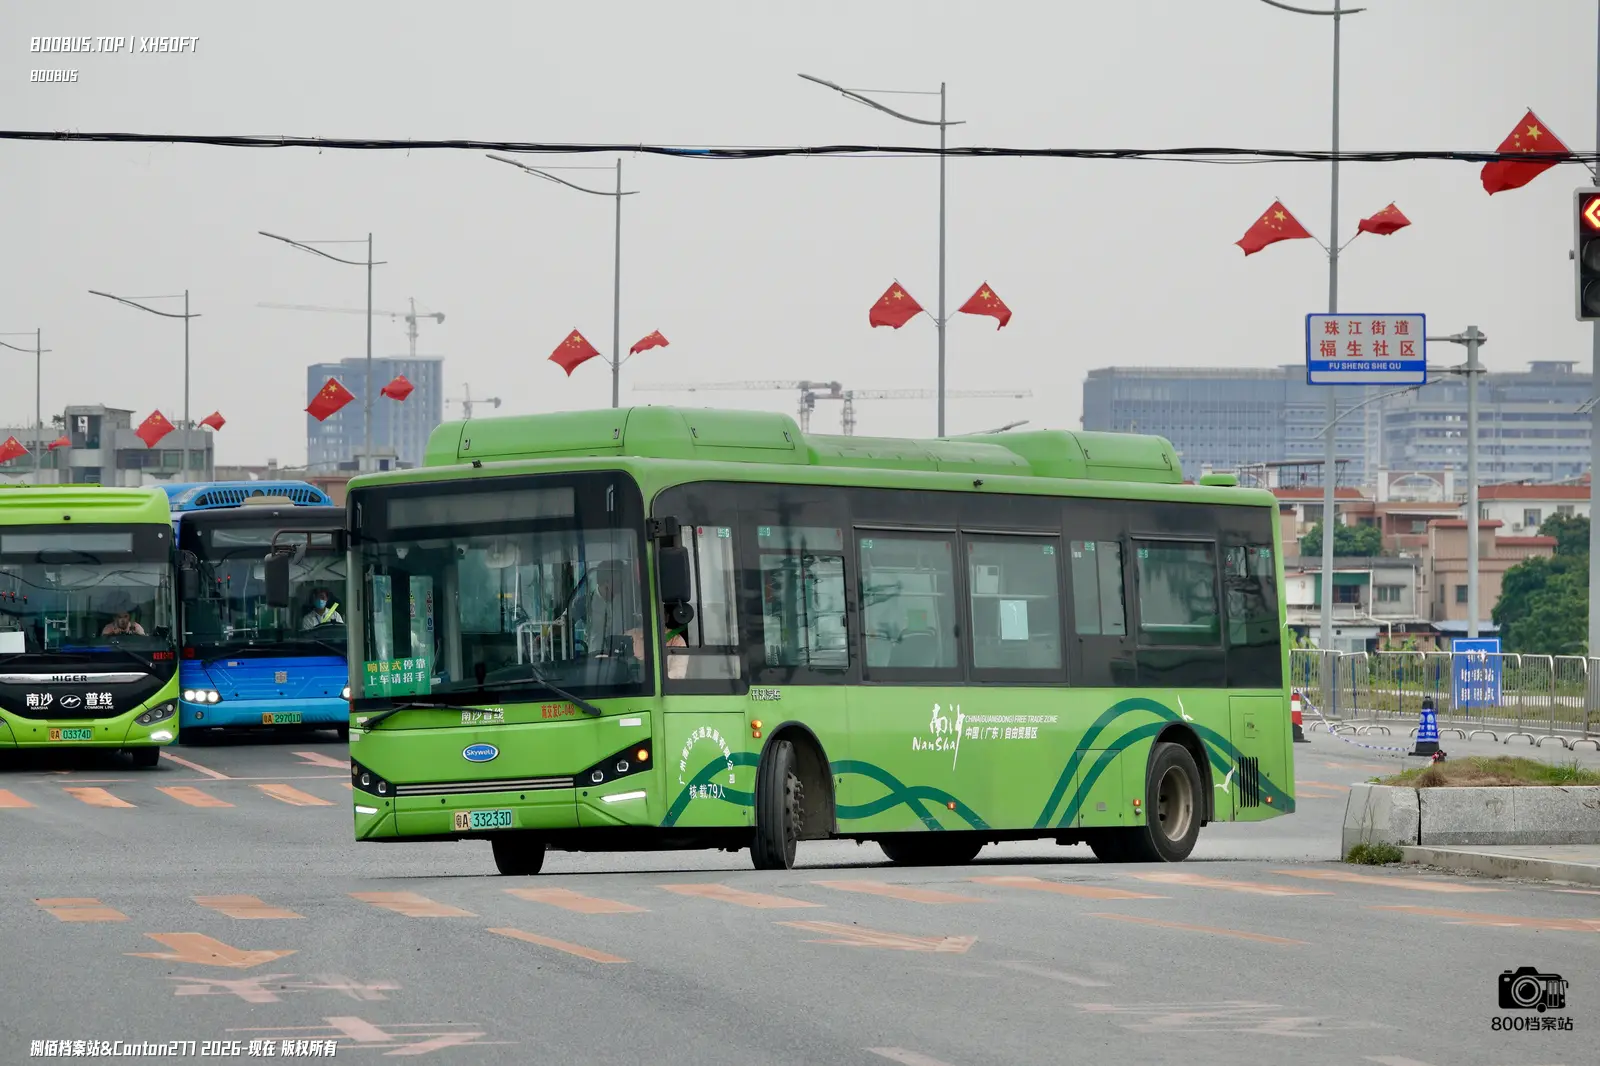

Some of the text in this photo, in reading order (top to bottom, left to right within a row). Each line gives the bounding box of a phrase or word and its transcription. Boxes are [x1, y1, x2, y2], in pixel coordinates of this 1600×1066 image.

[1324, 320, 1410, 336] 珠江街道
[1319, 340, 1416, 357] 福生社区
[1329, 362, 1402, 371] FU SHENG SHE QU
[367, 658, 426, 673] 响应式停靠
[368, 671, 426, 686] 上车请招手
[26, 692, 113, 707] 南沙 普线
